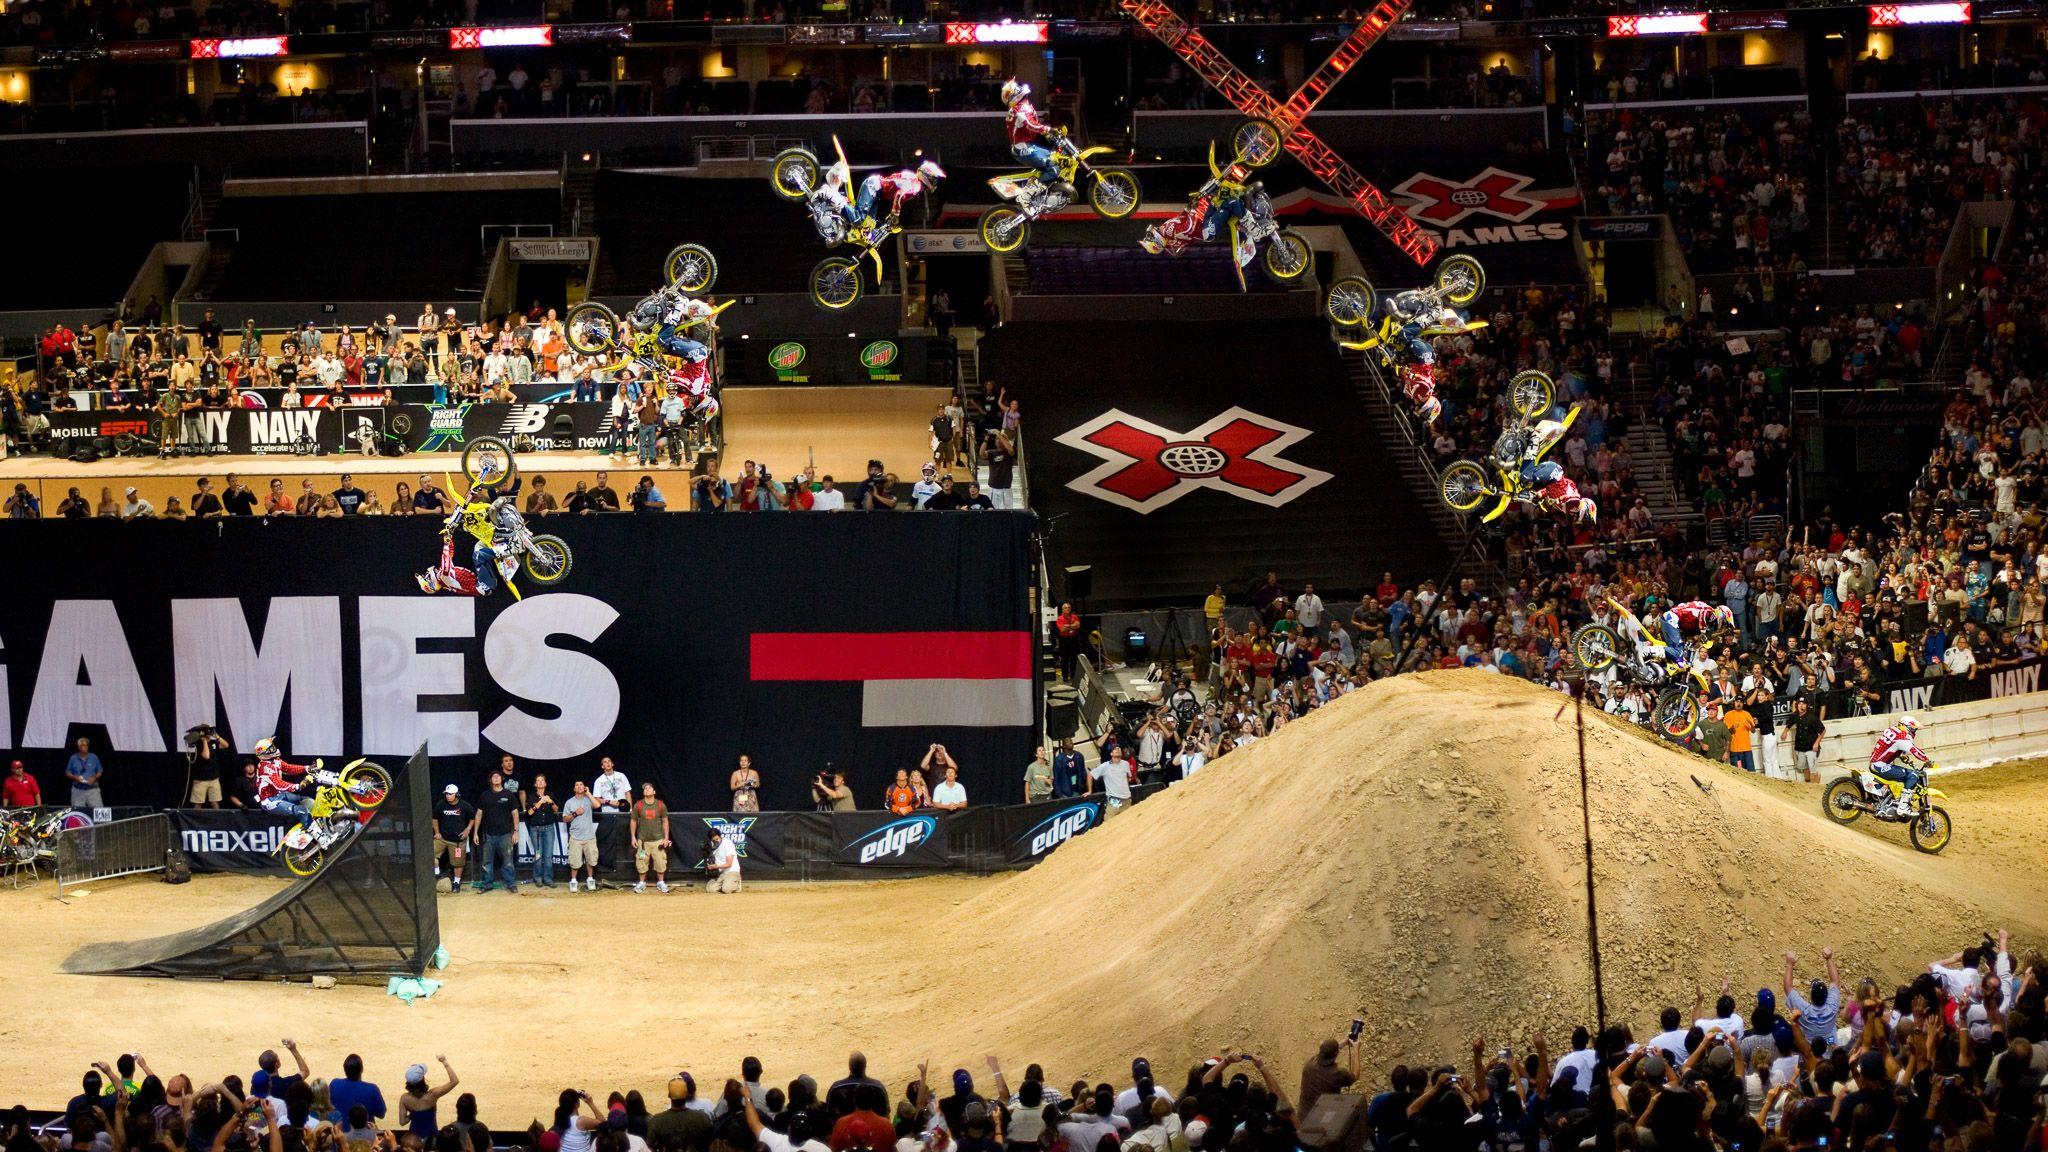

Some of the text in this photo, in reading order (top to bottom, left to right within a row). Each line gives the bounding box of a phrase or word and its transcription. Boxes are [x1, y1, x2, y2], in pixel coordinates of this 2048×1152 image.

[1604, 223, 1649, 232] PEPSI
[430, 419, 463, 428] GUARD
[433, 410, 463, 419] RIGHT
[51, 421, 148, 438] MOBILE ESPN
[250, 410, 321, 443] NAVY
[251, 444, 289, 452] accelerate
[578, 437, 608, 448] new
[0, 593, 621, 760] AMES
[1990, 664, 2041, 699] NAVY
[182, 826, 285, 853] maxell
[861, 820, 926, 863] edge
[1031, 808, 1088, 856] edge
